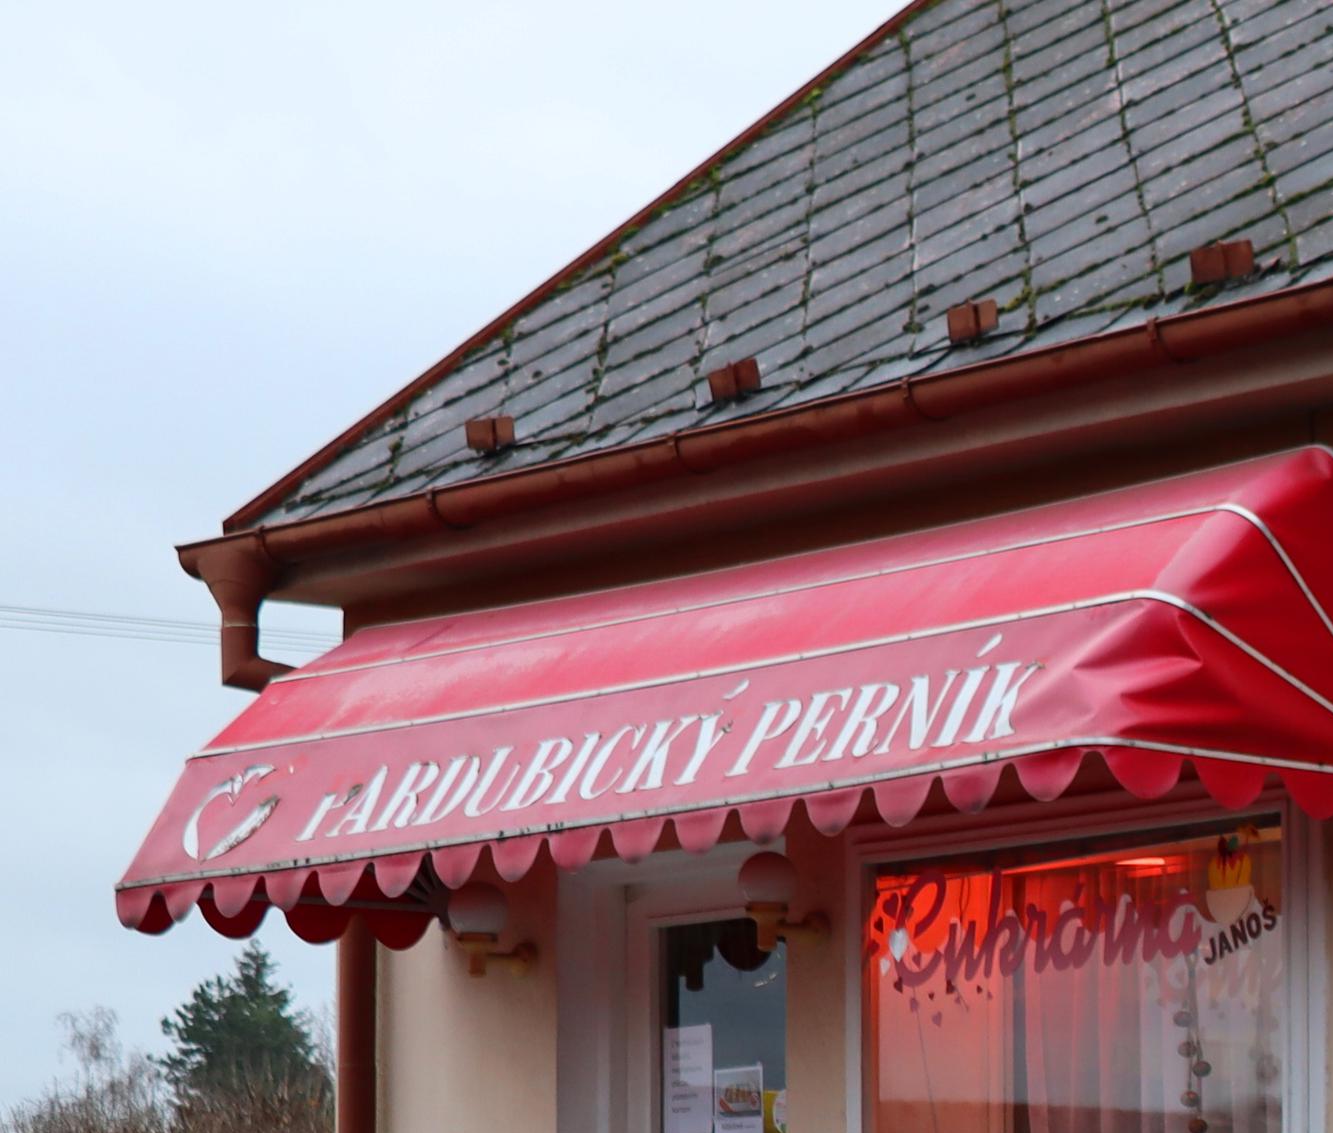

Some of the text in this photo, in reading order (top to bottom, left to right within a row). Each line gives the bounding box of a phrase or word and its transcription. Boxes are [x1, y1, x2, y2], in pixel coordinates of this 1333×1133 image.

[724, 632, 1046, 778] PERNÍK
[896, 866, 1203, 989] Cukrárna
[1203, 896, 1278, 966] JANOŠ
